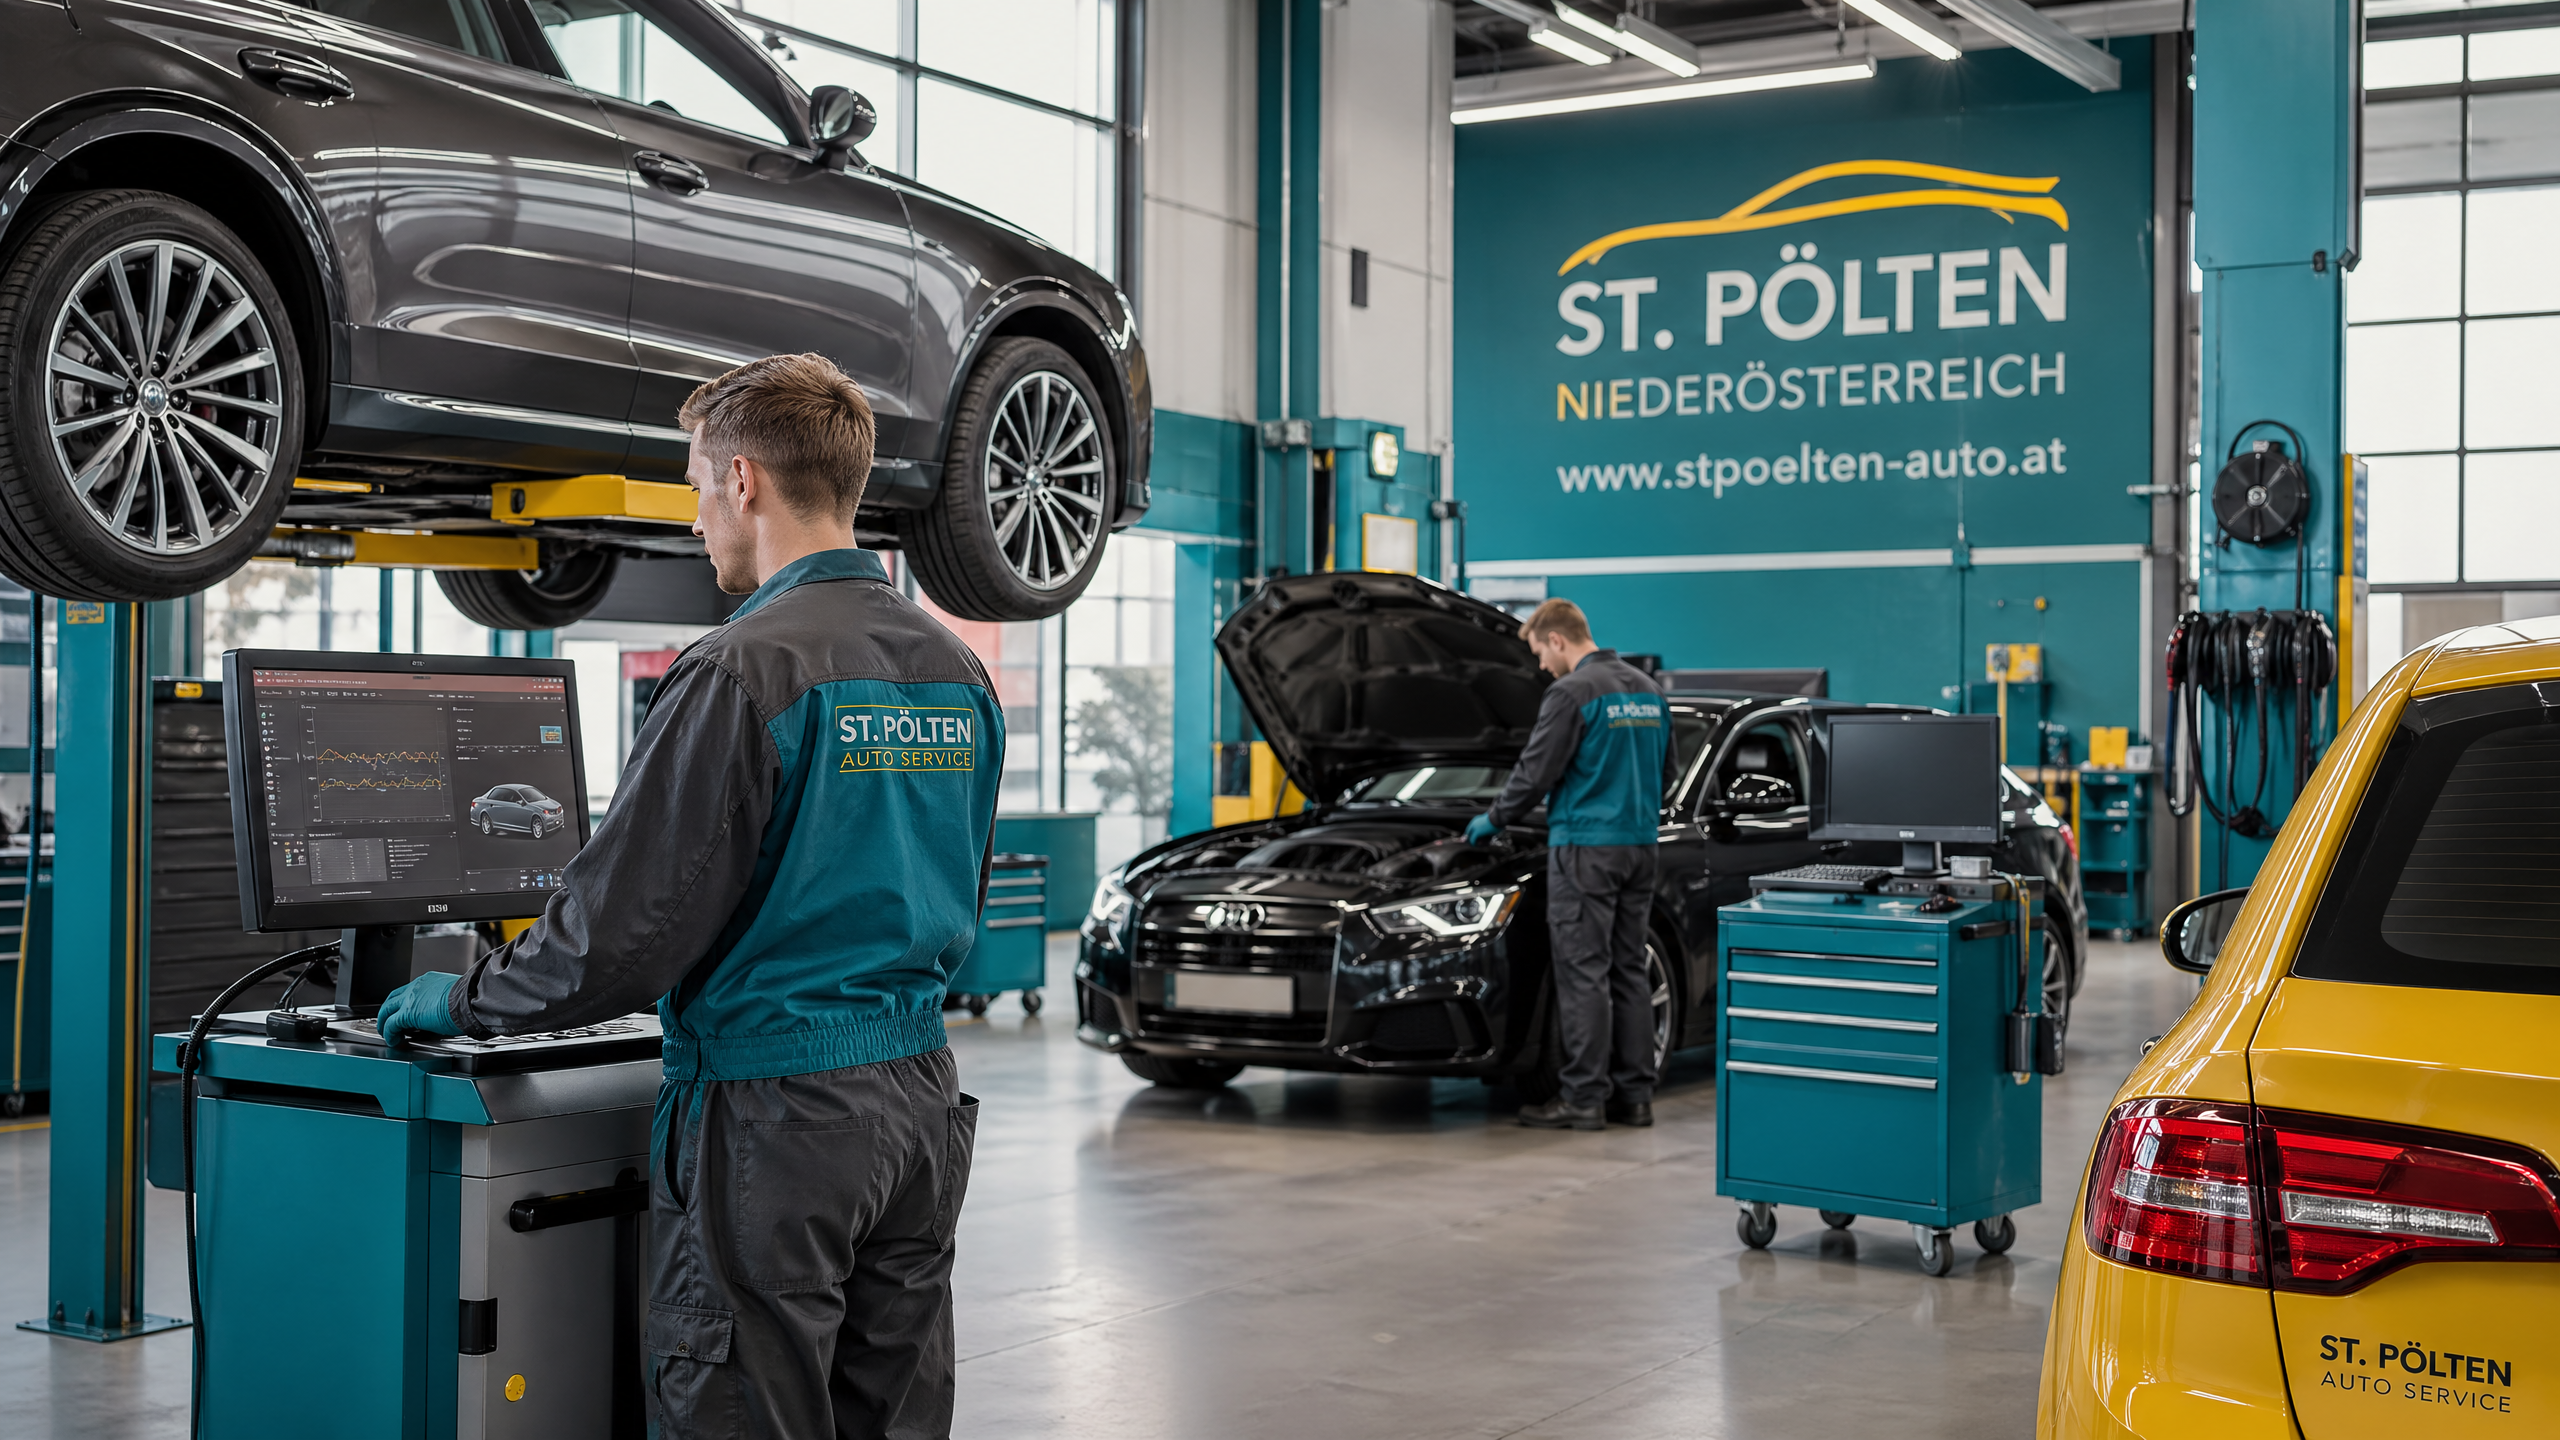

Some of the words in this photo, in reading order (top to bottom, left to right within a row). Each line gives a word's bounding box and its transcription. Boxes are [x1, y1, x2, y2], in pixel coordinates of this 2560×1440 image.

[1556, 276, 1675, 357] ST.
[1705, 242, 2068, 346] PÖLTEN
[1556, 352, 2066, 422] NIEDERÖSTERREICH
[1557, 438, 2068, 500] www.stpoelten-auto.at
[839, 714, 879, 743] ST.
[883, 709, 972, 744] PÖLTEN
[840, 750, 894, 769] AUTO
[901, 750, 971, 767] SERVICE
[2319, 1334, 2367, 1366] ST.
[2379, 1340, 2512, 1388] PÖLTEN
[2320, 1370, 2392, 1396] AUTO
[2404, 1382, 2512, 1414] SERVICE
